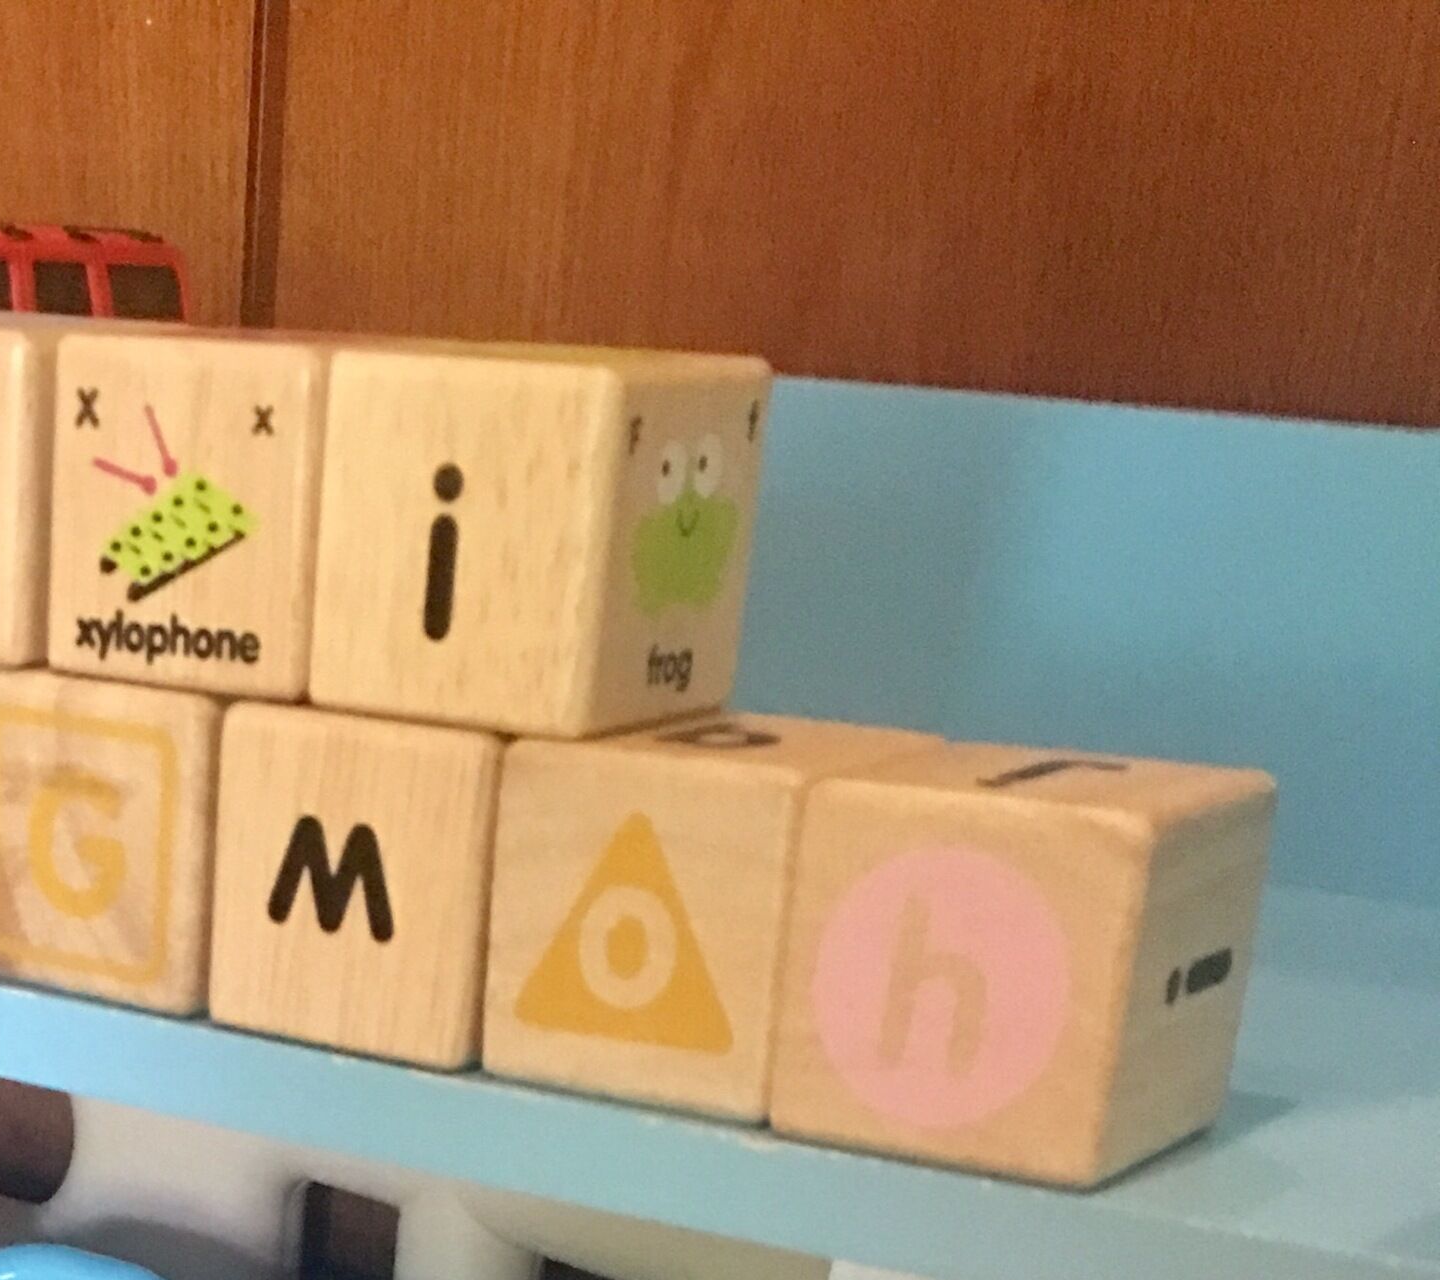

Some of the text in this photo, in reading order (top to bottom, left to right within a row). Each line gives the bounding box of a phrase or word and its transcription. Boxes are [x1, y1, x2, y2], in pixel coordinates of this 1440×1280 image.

[422, 462, 465, 643] i
[75, 612, 262, 666] xylophone
[646, 642, 695, 693] frog
[28, 765, 128, 920] G
[876, 876, 990, 1082] h
